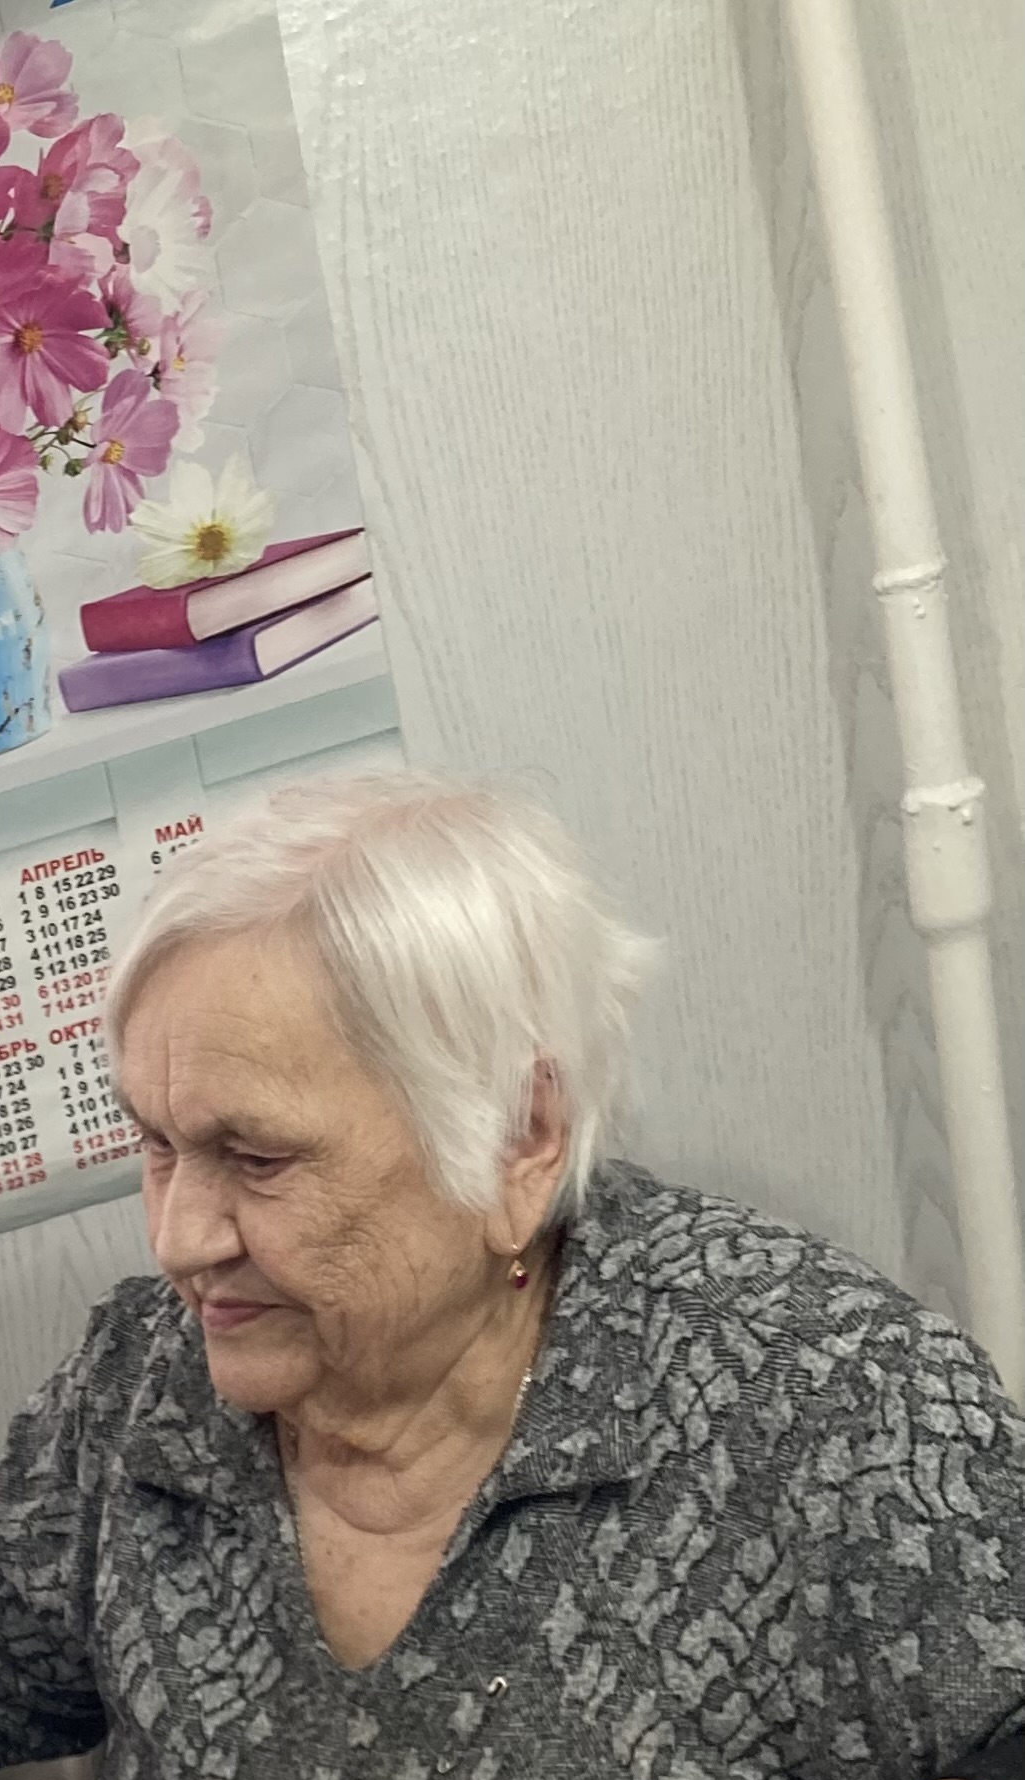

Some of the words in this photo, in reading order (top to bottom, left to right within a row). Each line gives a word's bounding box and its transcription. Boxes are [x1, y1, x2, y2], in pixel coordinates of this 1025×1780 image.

[155, 812, 204, 845] МАЙ
[21, 848, 105, 885] АПРЕЛЬ
[150, 850, 162, 865] 6
[18, 891, 27, 905] 1
[35, 886, 45, 900] 8
[53, 877, 72, 894] 15
[74, 871, 95, 889] 22
[96, 864, 116, 882] 29
[21, 909, 32, 924] 2
[38, 904, 49, 919] 9
[56, 896, 76, 913] 16
[78, 889, 98, 907] 23
[100, 883, 120, 900] 30
[25, 929, 36, 944] 3
[39, 922, 58, 939] 10
[61, 915, 79, 932] 17
[82, 909, 103, 927] 24
[30, 948, 41, 961] 4
[44, 941, 61, 958] 11
[65, 934, 84, 951] 18
[86, 927, 107, 945] 25
[49, 1017, 101, 1045] ОКТЯ
[2, 1061, 22, 1078] 23
[25, 1054, 45, 1071] 30
[6, 1079, 27, 1096] 24
